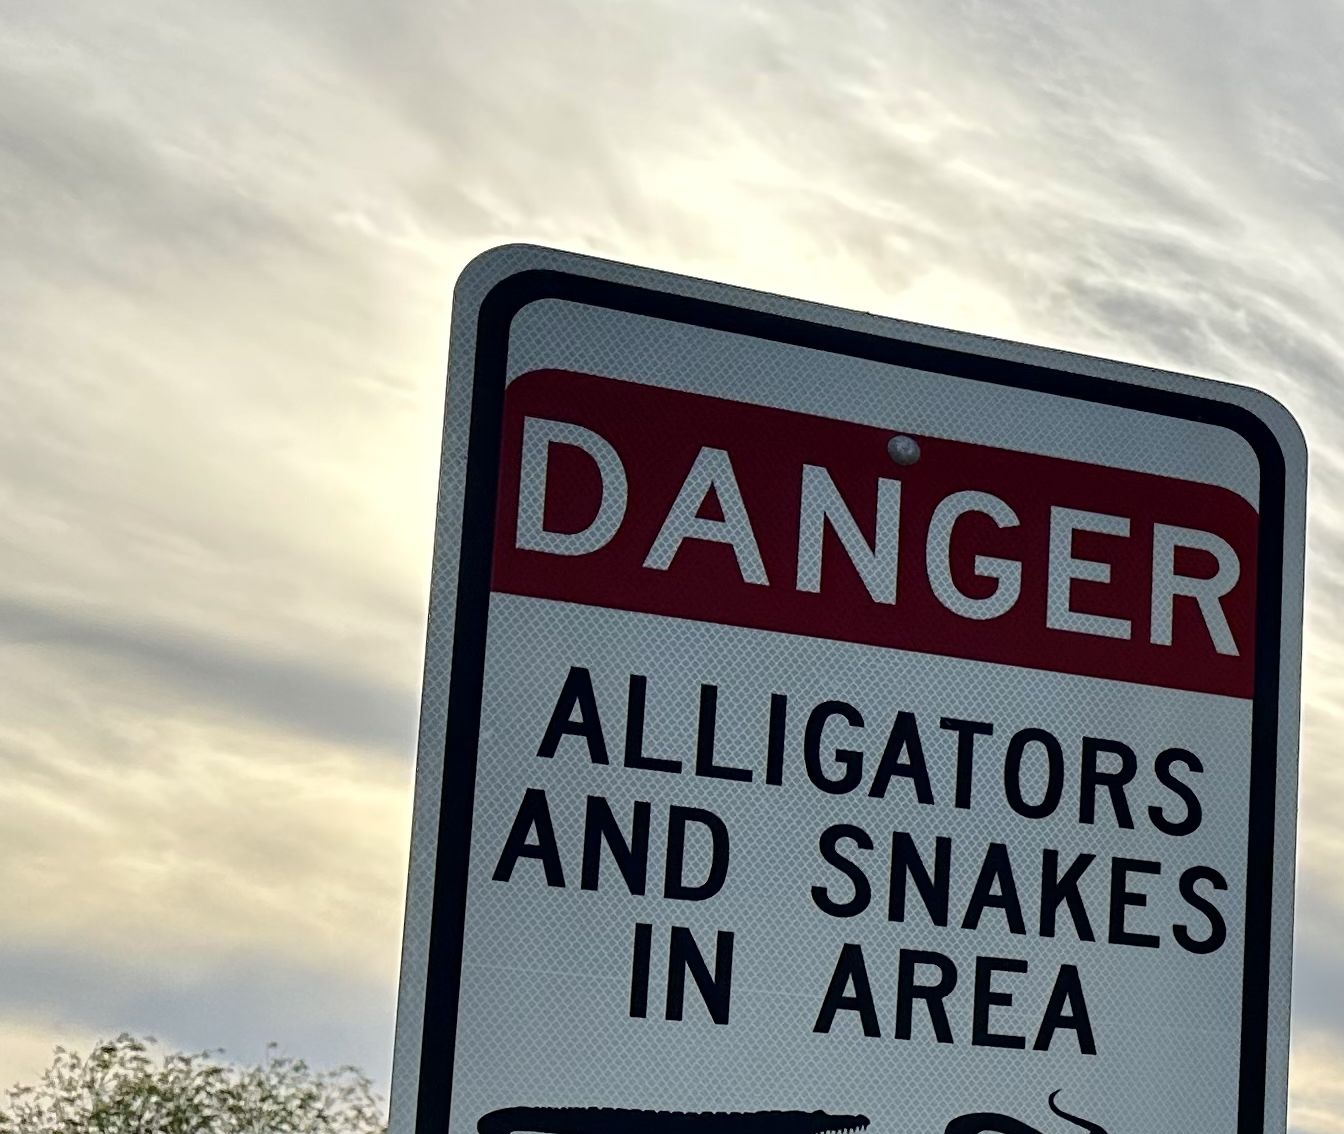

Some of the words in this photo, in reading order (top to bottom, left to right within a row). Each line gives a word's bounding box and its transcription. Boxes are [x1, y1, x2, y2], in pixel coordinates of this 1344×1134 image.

[514, 416, 1241, 656] DANGER
[537, 666, 1204, 837] ALLIGATORS
[491, 788, 730, 902] AND
[811, 824, 1228, 955] SNAKES
[629, 923, 734, 1025] IN
[812, 943, 1097, 1056] AREA
